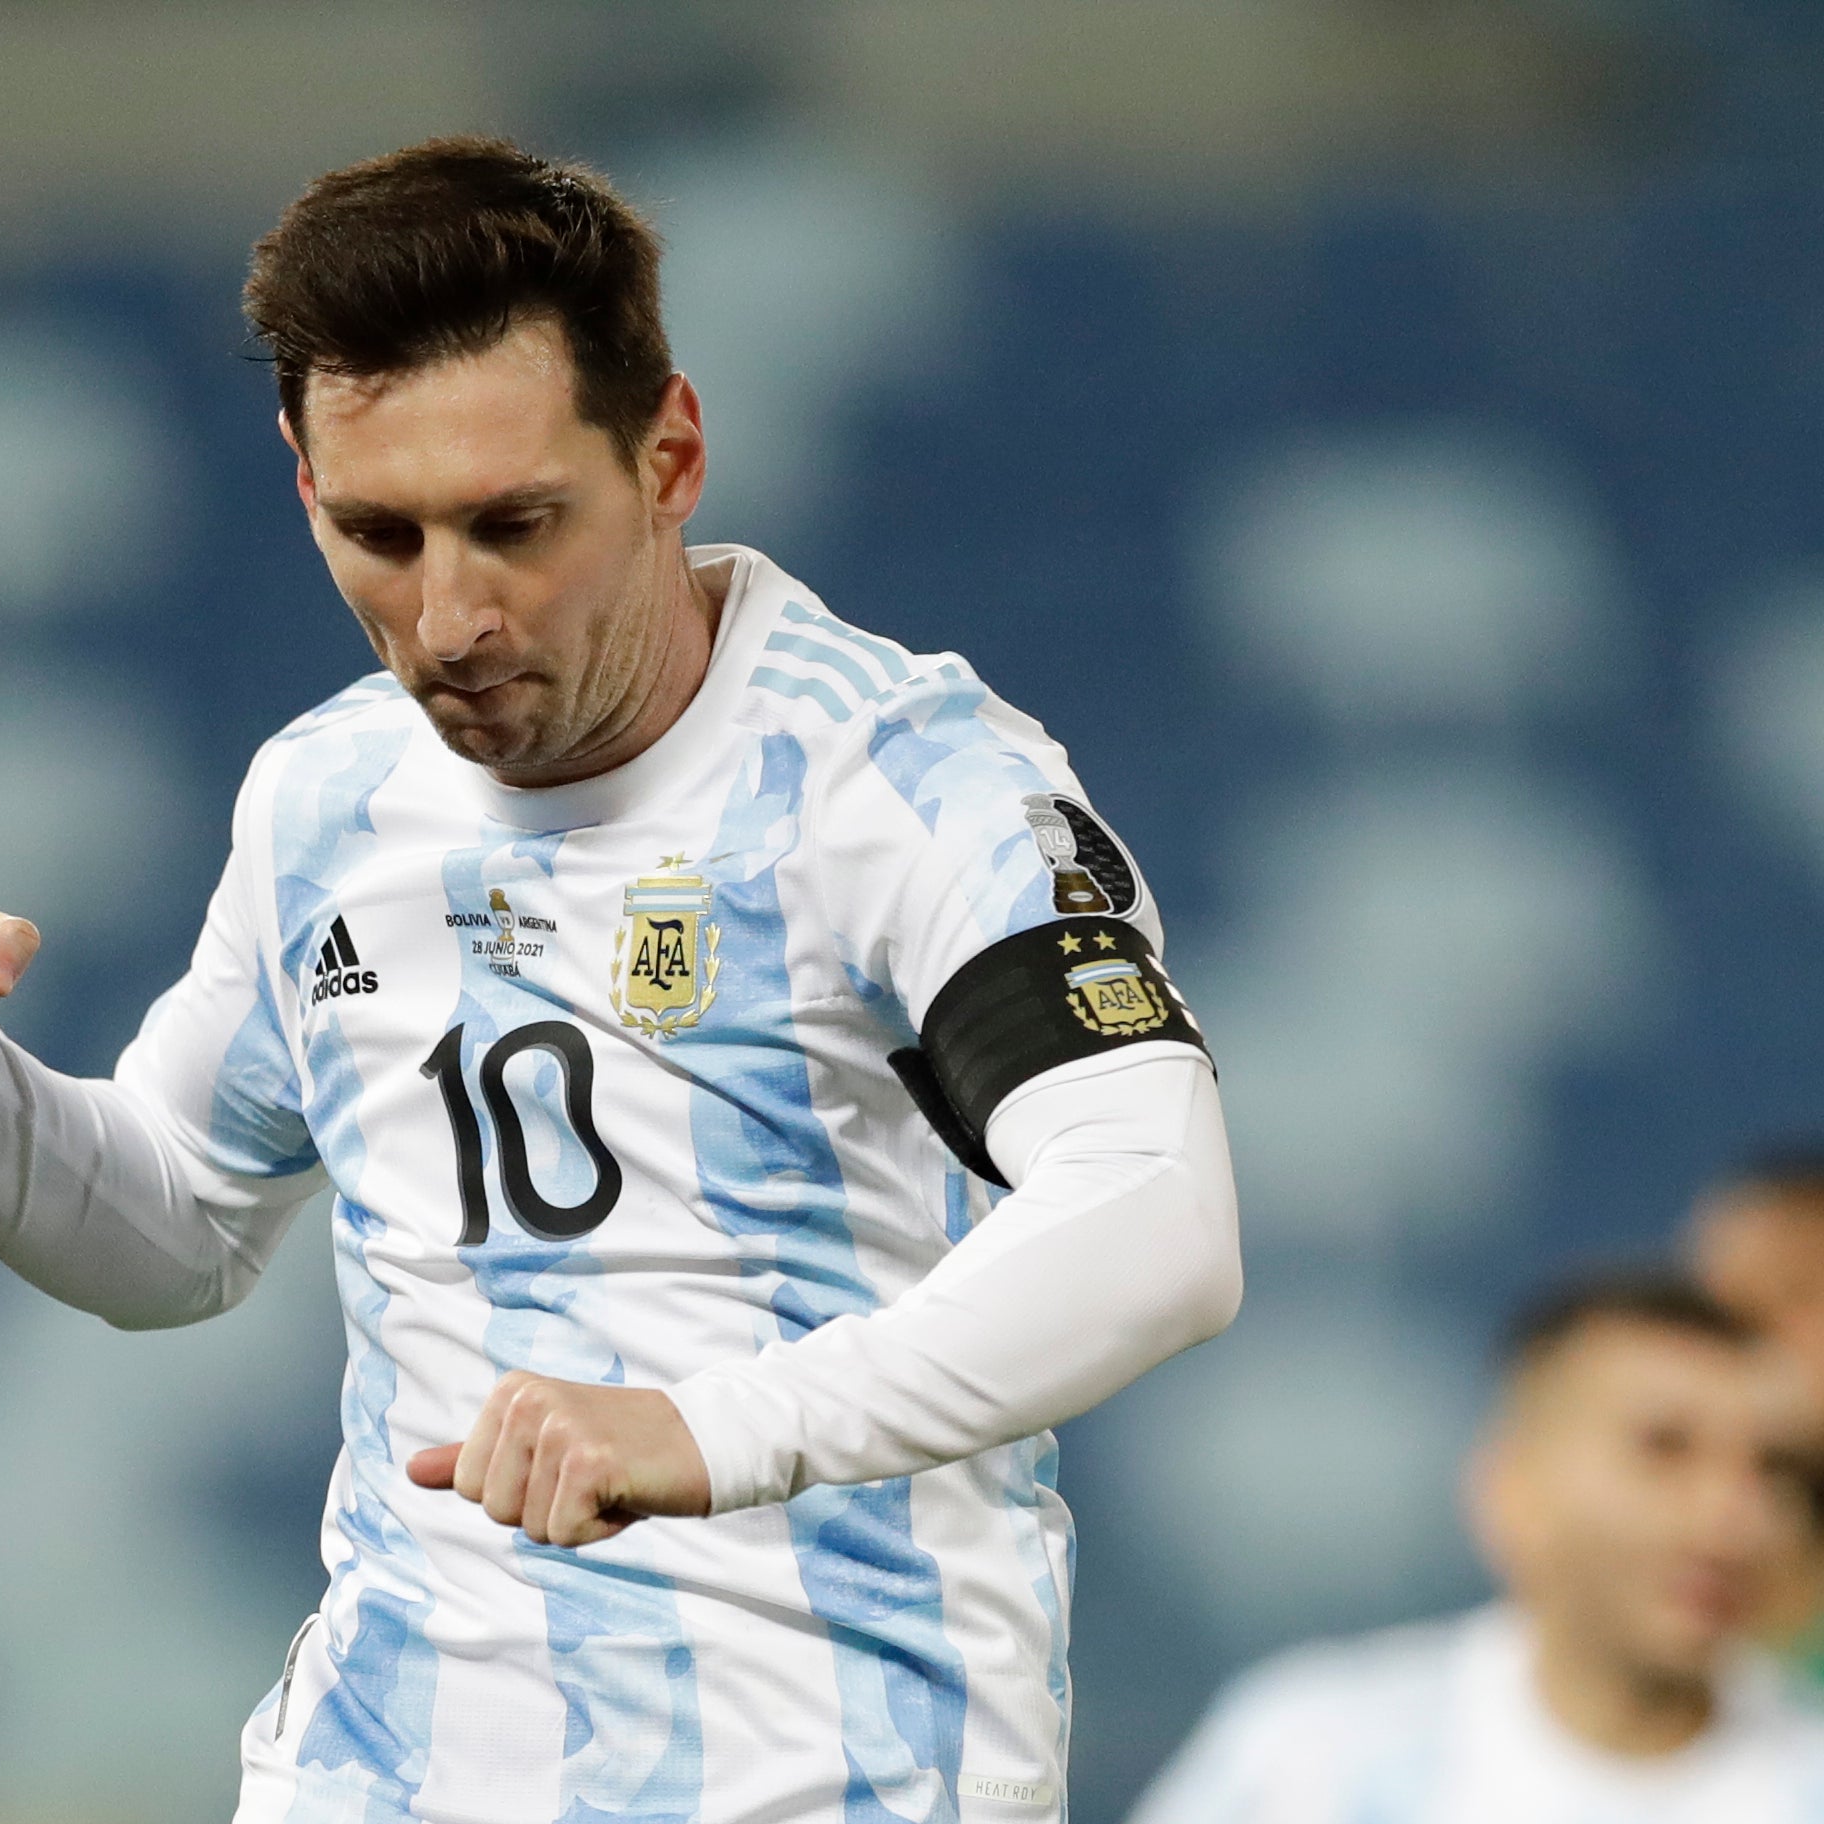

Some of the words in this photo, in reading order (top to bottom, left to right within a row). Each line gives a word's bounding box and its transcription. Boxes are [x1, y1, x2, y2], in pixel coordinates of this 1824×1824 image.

[1039, 828, 1072, 851] 14
[444, 913, 492, 928] BOLIVIA
[518, 915, 558, 934] ARGENTINA
[471, 940, 482, 955] 28
[484, 941, 515, 955] JUNIO
[517, 943, 544, 958] 2021
[631, 917, 690, 992] AFA
[311, 966, 379, 1008] adidas
[1097, 977, 1145, 1011] AFA
[418, 1020, 623, 1248] 10
[975, 1780, 1009, 1798] HEAT
